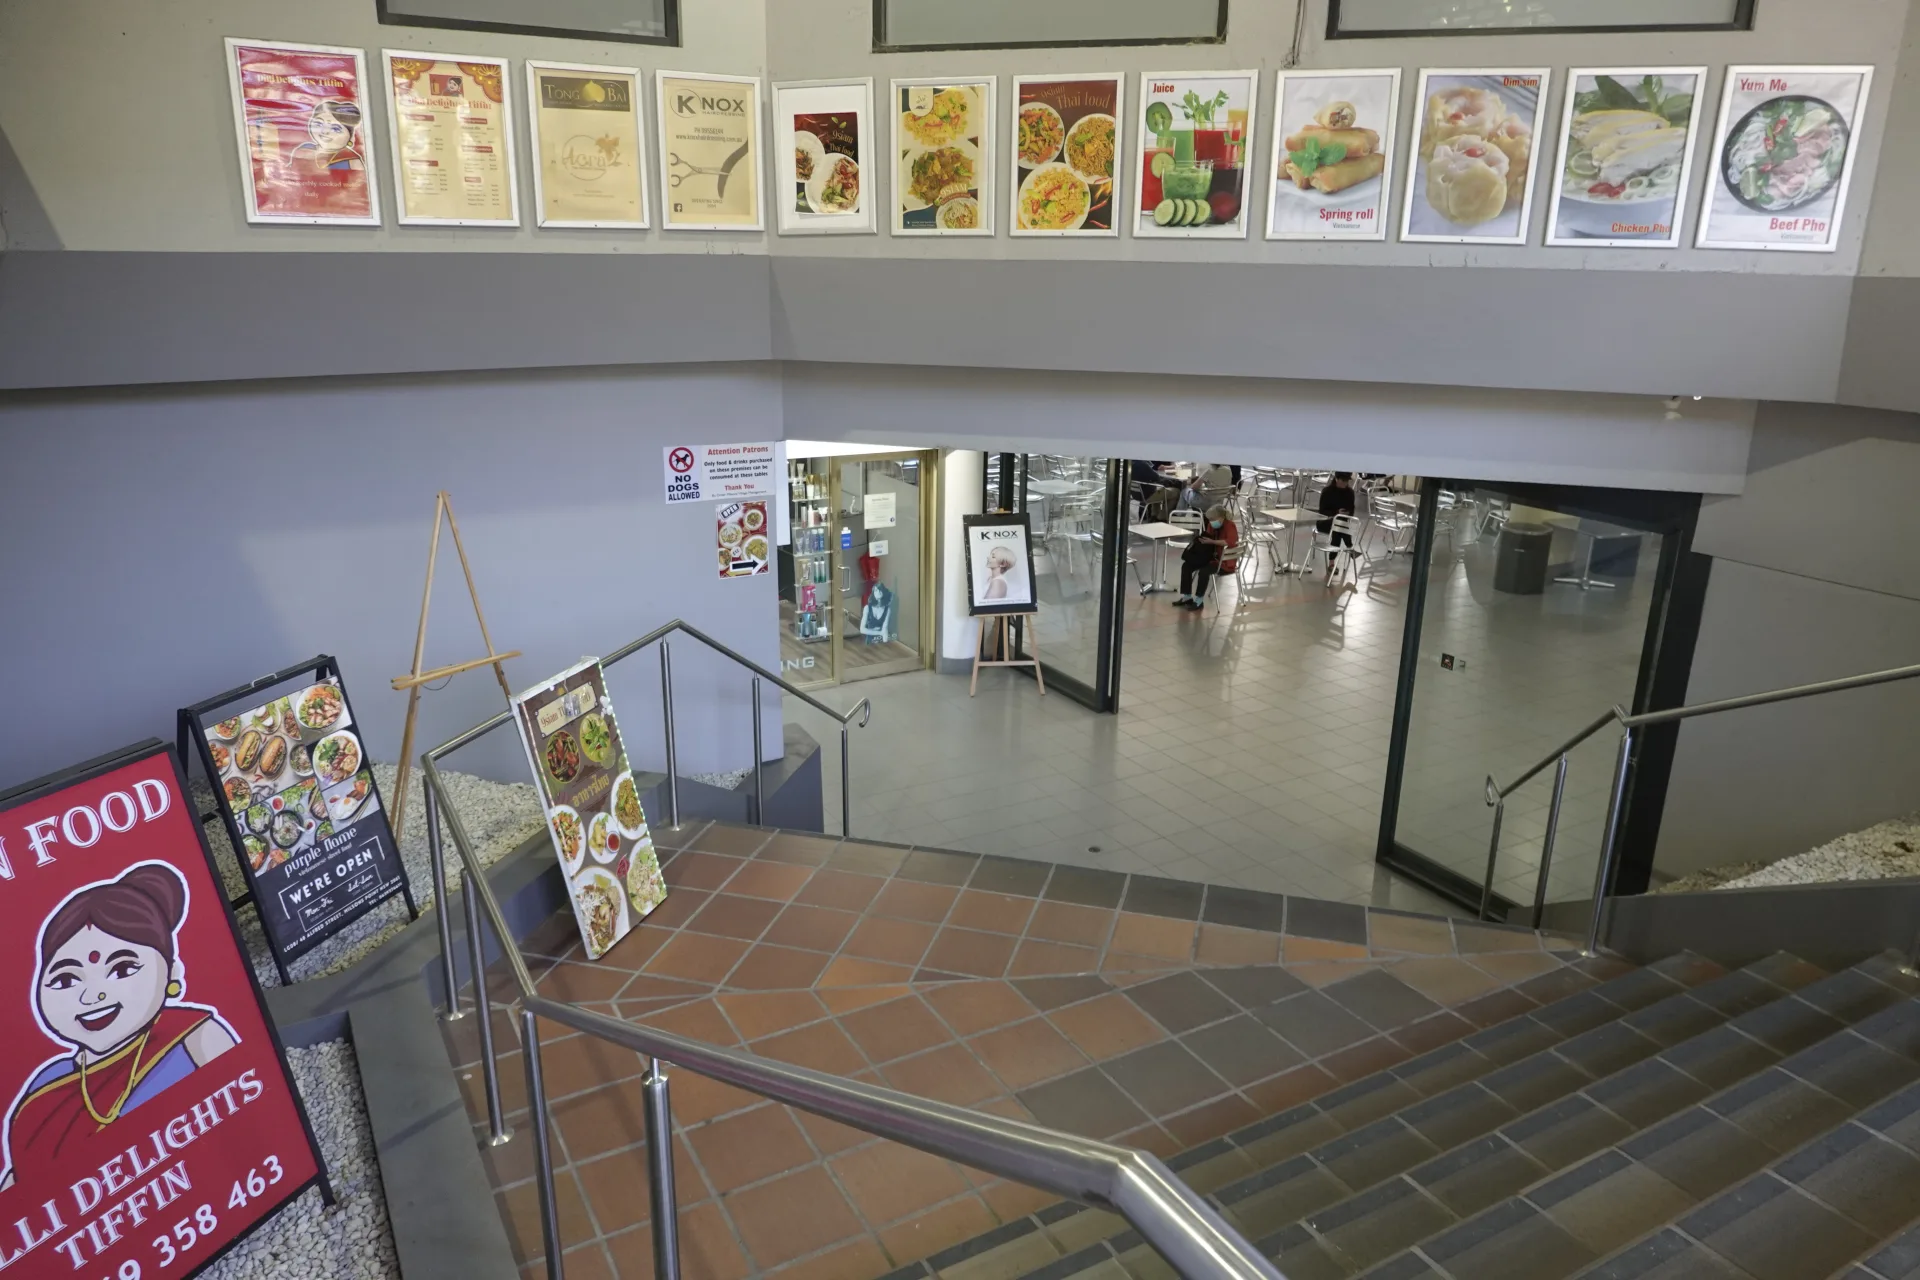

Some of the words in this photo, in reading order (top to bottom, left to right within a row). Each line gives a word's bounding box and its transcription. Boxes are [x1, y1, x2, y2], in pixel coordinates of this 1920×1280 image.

[1152, 82, 1175, 93] Juice
[1503, 76, 1520, 87] Dim
[1522, 77, 1538, 87] sim
[1740, 78, 1765, 91] Yum
[1769, 79, 1788, 91] Me
[1056, 91, 1081, 109] Thai
[1084, 91, 1111, 109] food
[1319, 207, 1353, 222] Spring
[1356, 208, 1374, 220] roll
[1611, 221, 1650, 233] Chicken
[1769, 217, 1799, 230] Beef
[1801, 218, 1826, 231] Pho
[707, 447, 741, 456] Attention
[742, 446, 769, 454] Patrons
[674, 474, 692, 483] NO
[667, 482, 699, 493] DOGS
[668, 491, 701, 501] ALLOWED
[23, 778, 171, 868] FOOD
[284, 847, 322, 879] purple
[324, 827, 358, 852] flame
[289, 872, 333, 904] WE'RE
[335, 848, 374, 877] OPEN
[306, 923, 325, 938] ALFRED
[343, 898, 364, 914] MILSONS
[364, 888, 379, 901] POINT
[379, 881, 390, 891] NSW
[69, 1068, 264, 1217] DELIGHTS
[54, 1160, 193, 1271] TIFFIN
[152, 1203, 218, 1269] 358
[227, 1154, 284, 1210] 463
